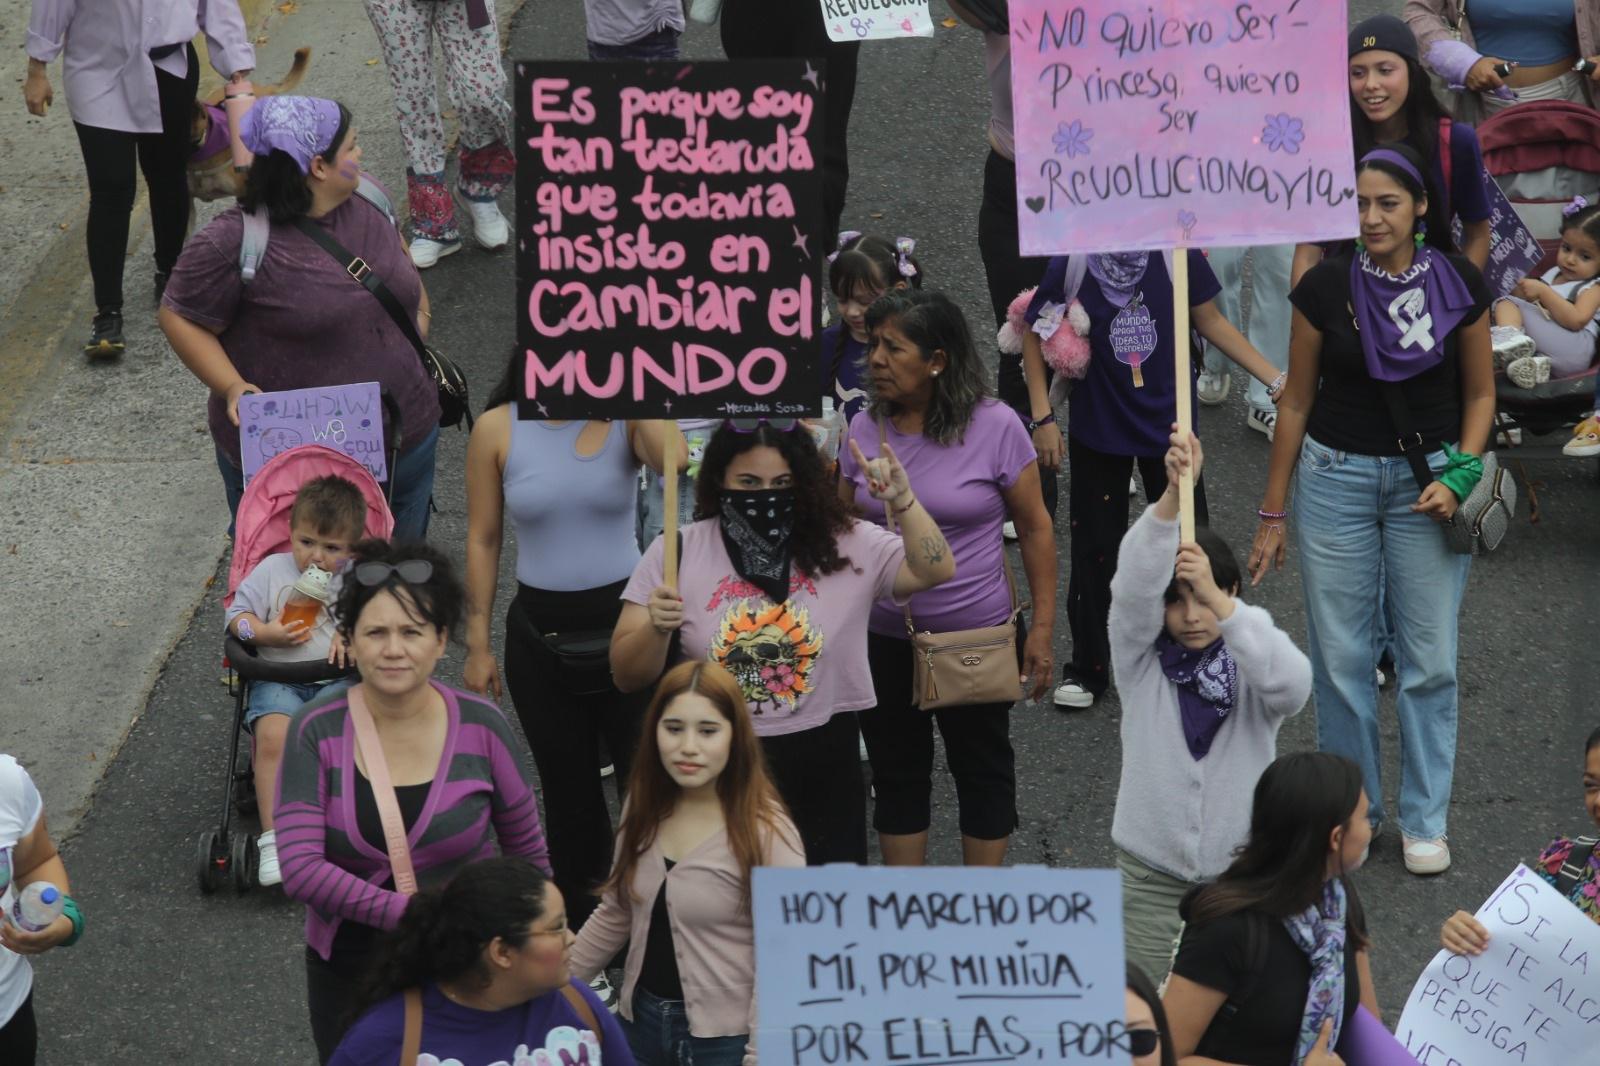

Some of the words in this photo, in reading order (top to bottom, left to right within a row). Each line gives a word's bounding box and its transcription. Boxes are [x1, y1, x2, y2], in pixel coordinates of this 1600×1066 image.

[1038, 7, 1085, 52] NO
[531, 78, 597, 124] Es
[619, 86, 744, 139] porque
[748, 85, 814, 136] soy
[528, 122, 614, 174] tan
[620, 117, 814, 174] testaruda
[536, 182, 618, 232] que
[532, 220, 686, 273] insisto
[709, 233, 771, 273] en
[767, 273, 813, 340] el
[1112, 326, 1135, 335] APAGA
[1138, 325, 1152, 333] TUS
[524, 341, 788, 401] MUNDO
[311, 419, 347, 445] 8M
[780, 890, 848, 927] HOY
[867, 890, 1019, 931] MARCHO
[1029, 892, 1096, 926] POR
[808, 941, 866, 996] MÍ,
[878, 951, 945, 992] POR
[951, 953, 988, 988] MI
[1506, 942, 1540, 982] TE
[1558, 937, 1589, 975] LA
[1418, 978, 1529, 1062] PERSIGA
[1442, 953, 1512, 1008] QUE
[1523, 1003, 1561, 1042] TE
[791, 1019, 869, 1066] POR
[883, 1015, 1044, 1061] ELLAS,
[1057, 1018, 1133, 1058] POR
